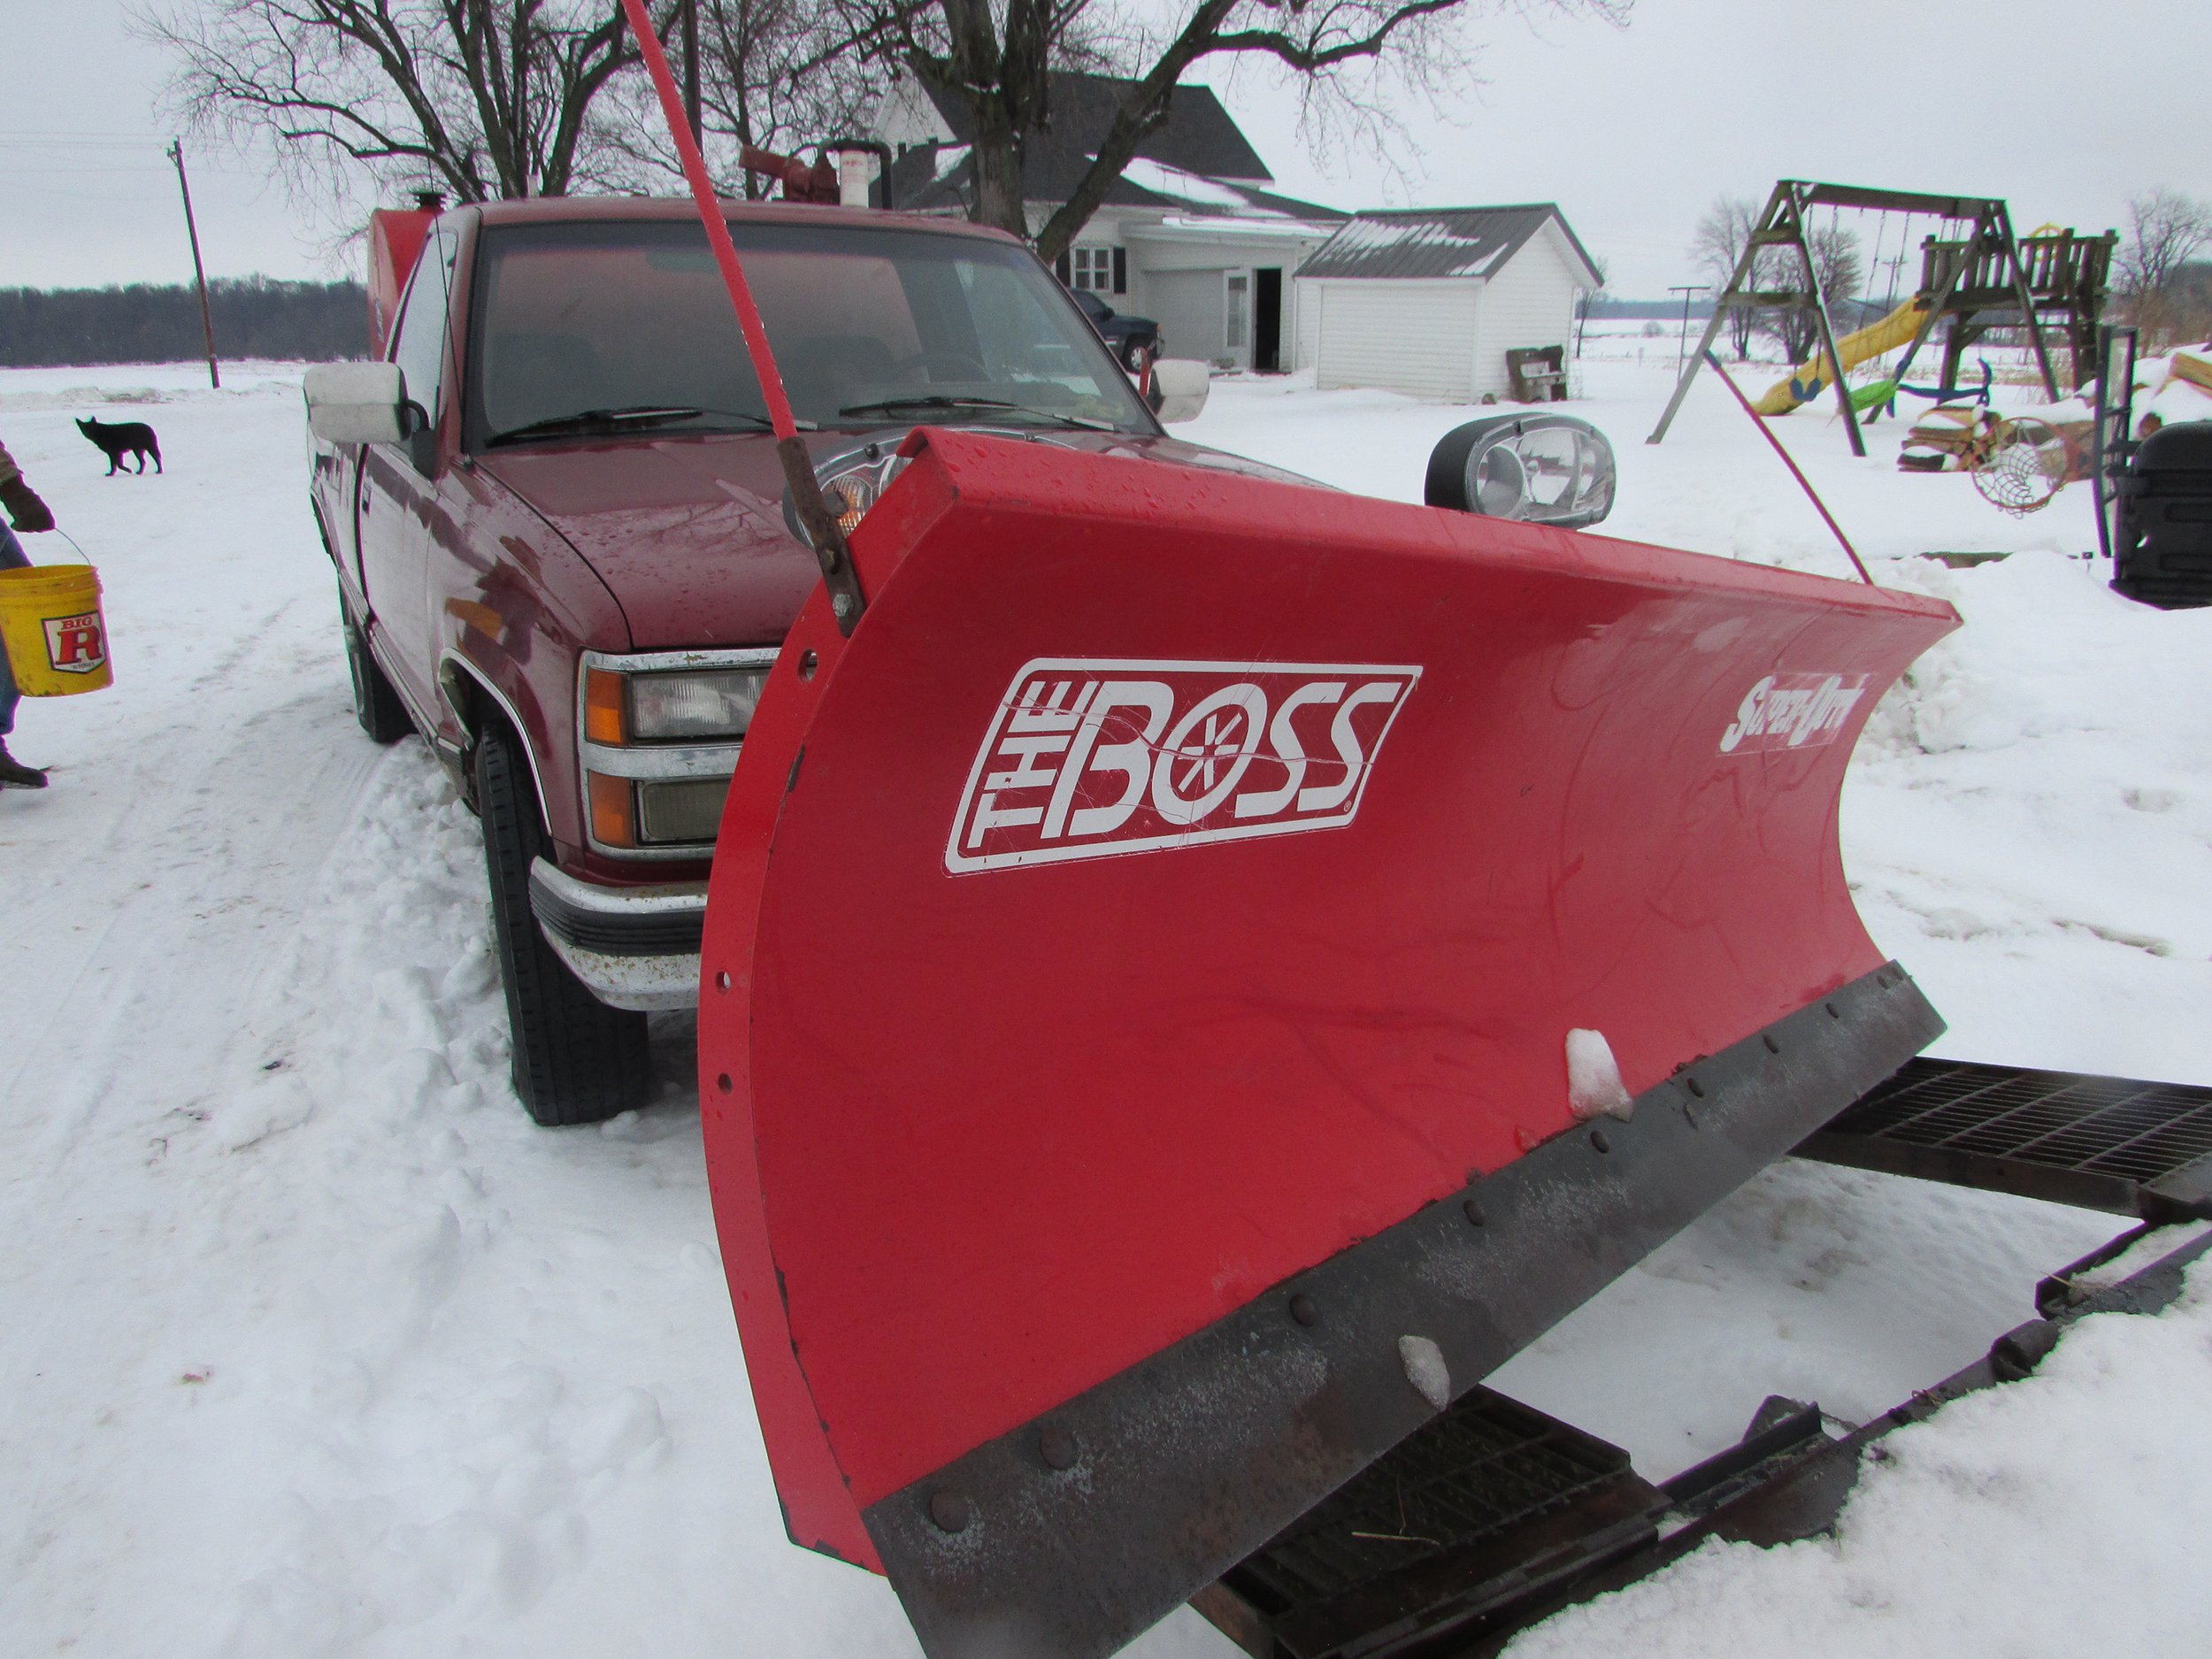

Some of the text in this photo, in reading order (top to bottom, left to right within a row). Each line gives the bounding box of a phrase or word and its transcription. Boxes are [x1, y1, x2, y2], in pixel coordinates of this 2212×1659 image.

[62, 617, 93, 630] BIG
[56, 626, 102, 665] R
[966, 680, 1402, 849] THE BOSS
